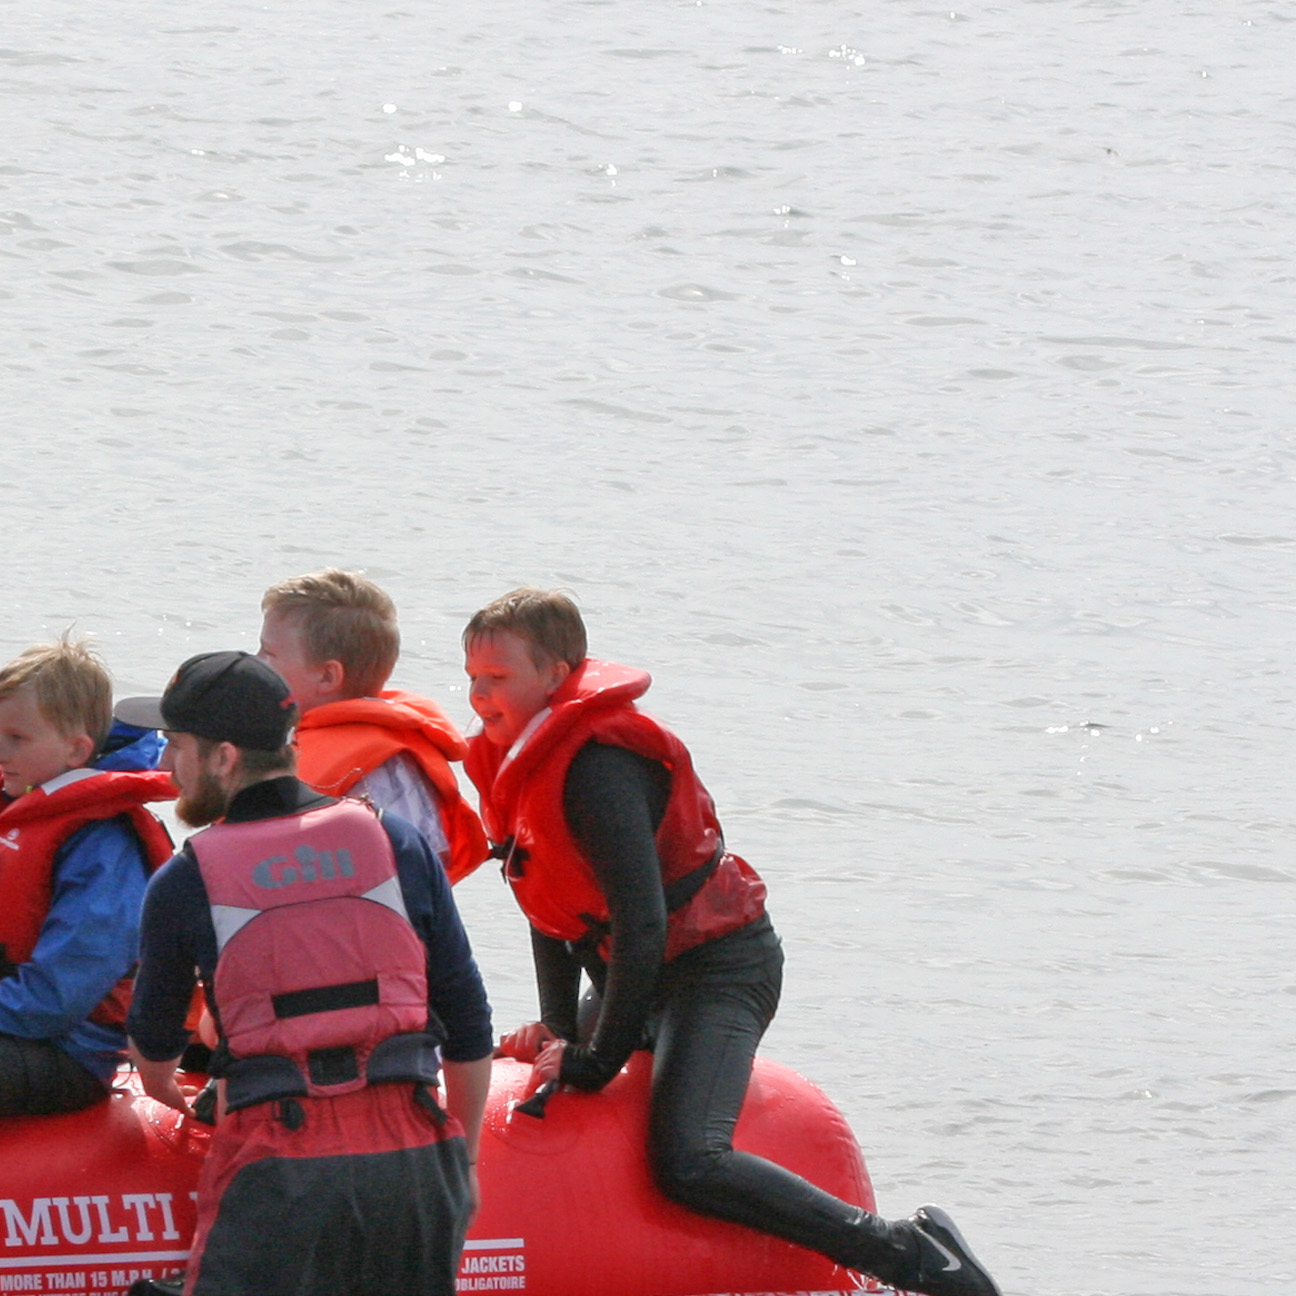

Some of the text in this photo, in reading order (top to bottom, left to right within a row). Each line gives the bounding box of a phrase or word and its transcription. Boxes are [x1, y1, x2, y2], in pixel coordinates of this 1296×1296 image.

[253, 845, 355, 889] Gill
[0, 1273, 43, 1291] MORE
[46, 1271, 86, 1289] THAN
[90, 1270, 108, 1288] 15
[461, 1255, 525, 1274] JACKETS
